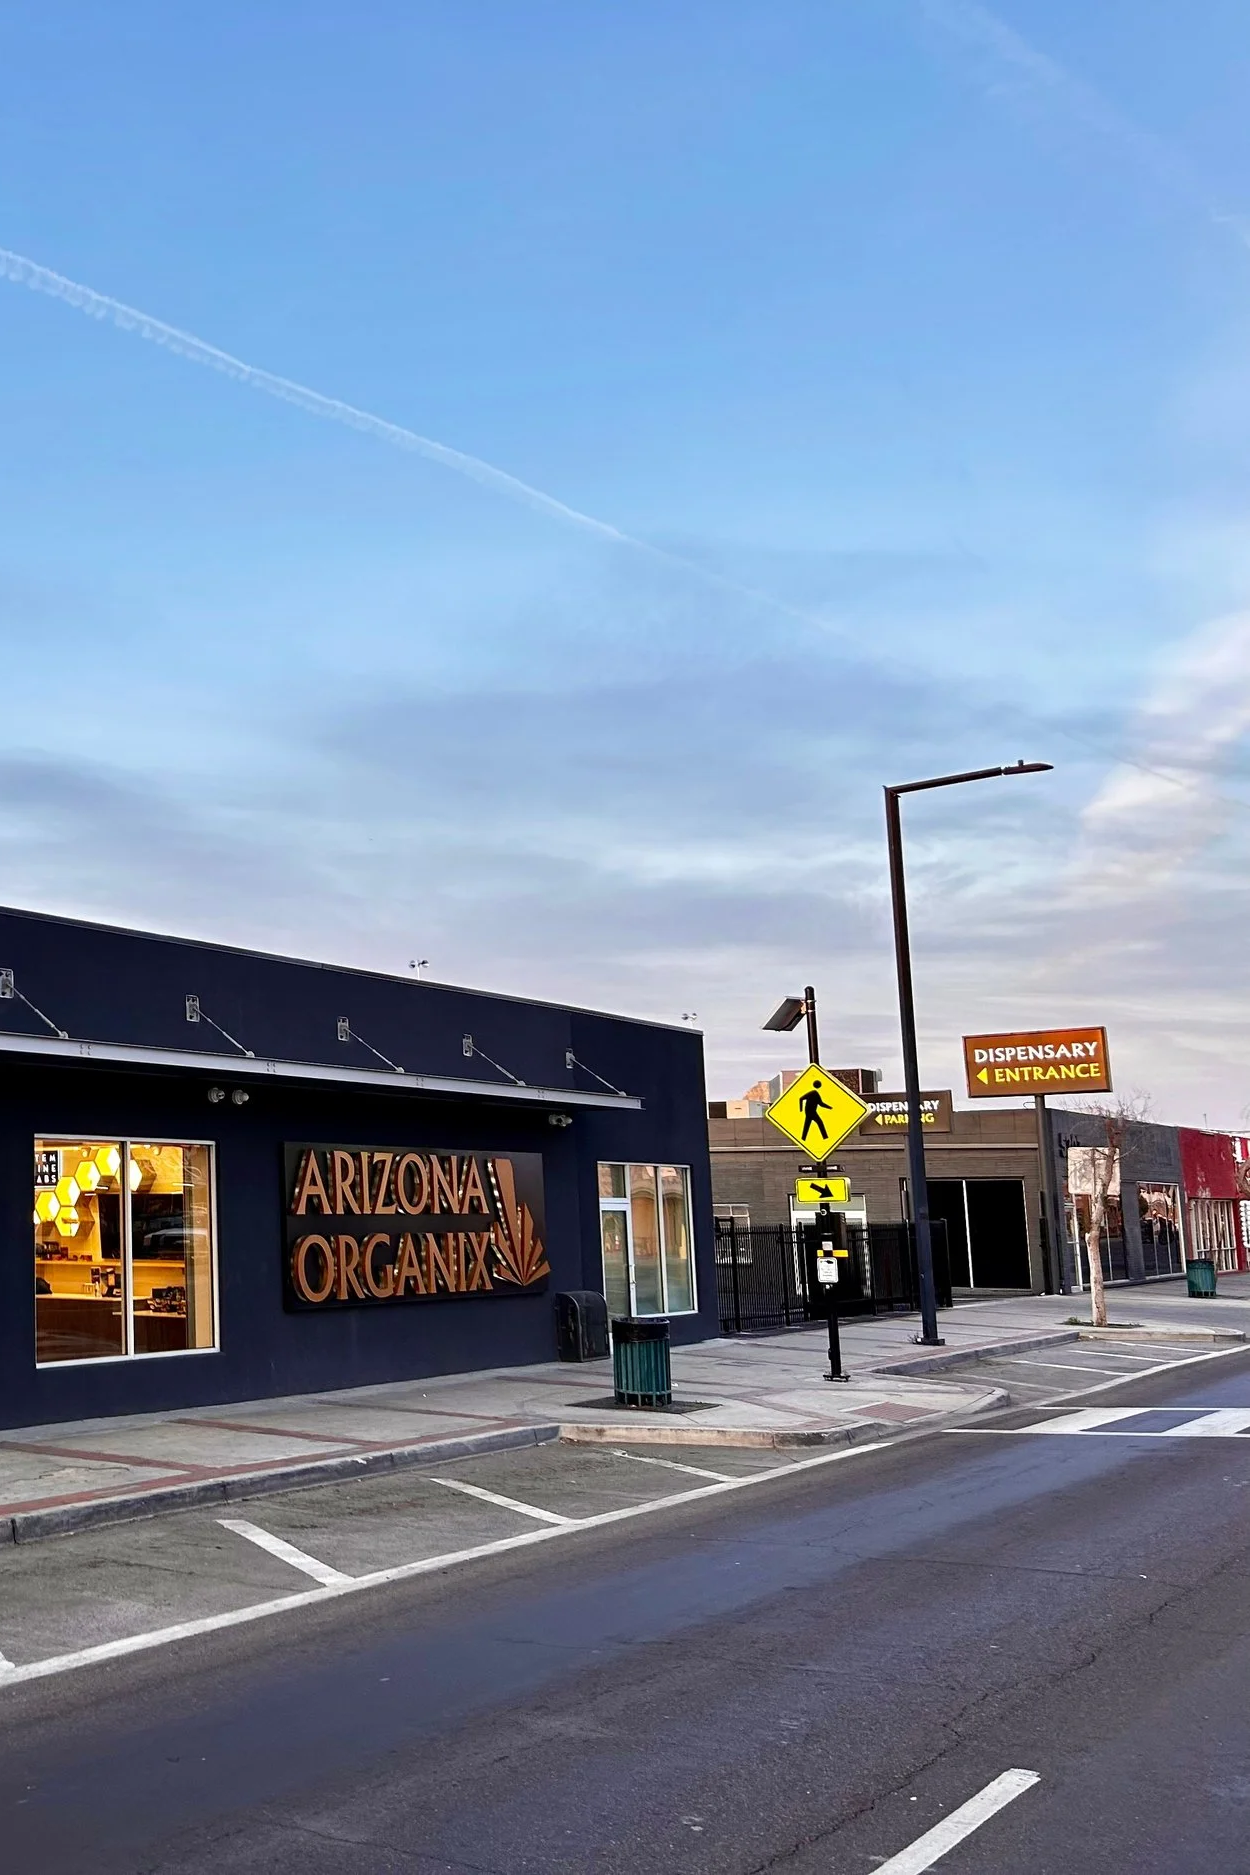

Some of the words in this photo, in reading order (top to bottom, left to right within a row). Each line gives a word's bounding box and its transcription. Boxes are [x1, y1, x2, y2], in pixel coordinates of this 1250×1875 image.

[973, 1041, 1098, 1063] DISPENSARY
[994, 1062, 1101, 1083] ENTRANCE
[869, 1100, 939, 1112] DISPENRY
[35, 1153, 56, 1162] TEM
[37, 1164, 56, 1173] INE
[36, 1175, 56, 1184] ABS
[291, 1149, 489, 1215] ARIZONA
[291, 1232, 493, 1302] ORGANIX
